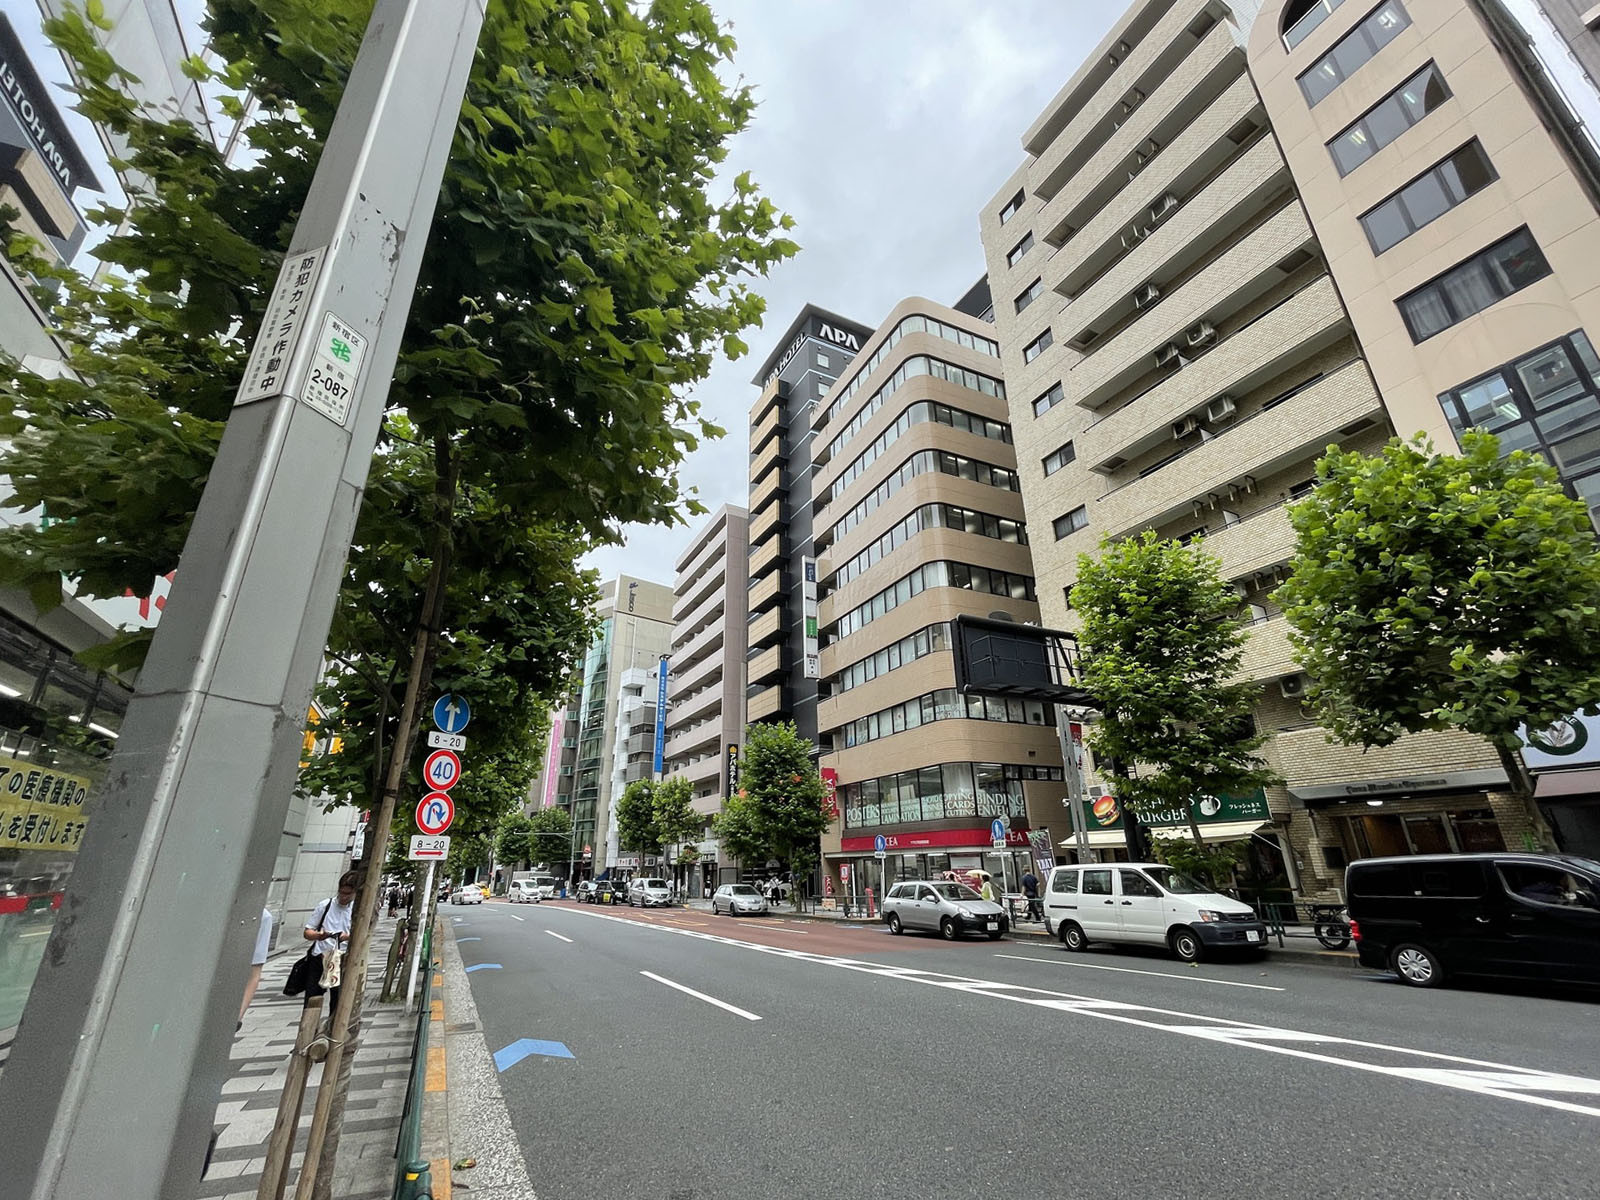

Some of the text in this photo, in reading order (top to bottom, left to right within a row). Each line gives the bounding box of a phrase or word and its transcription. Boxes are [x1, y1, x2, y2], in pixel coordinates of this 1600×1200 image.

[260, 256, 316, 391] 防犯カメラ作動中
[819, 323, 860, 351] APA
[780, 332, 806, 370] HOTEL
[311, 368, 349, 400] 2-087
[433, 761, 453, 780] 40
[729, 753, 737, 785] アパホテル
[947, 800, 975, 810] CARDS
[977, 793, 1025, 805] BINDING
[846, 804, 880, 822] POSTERS
[881, 810, 921, 826] LAMINATION
[946, 809, 975, 817] CUTTING
[417, 840, 445, 849] 8-20
